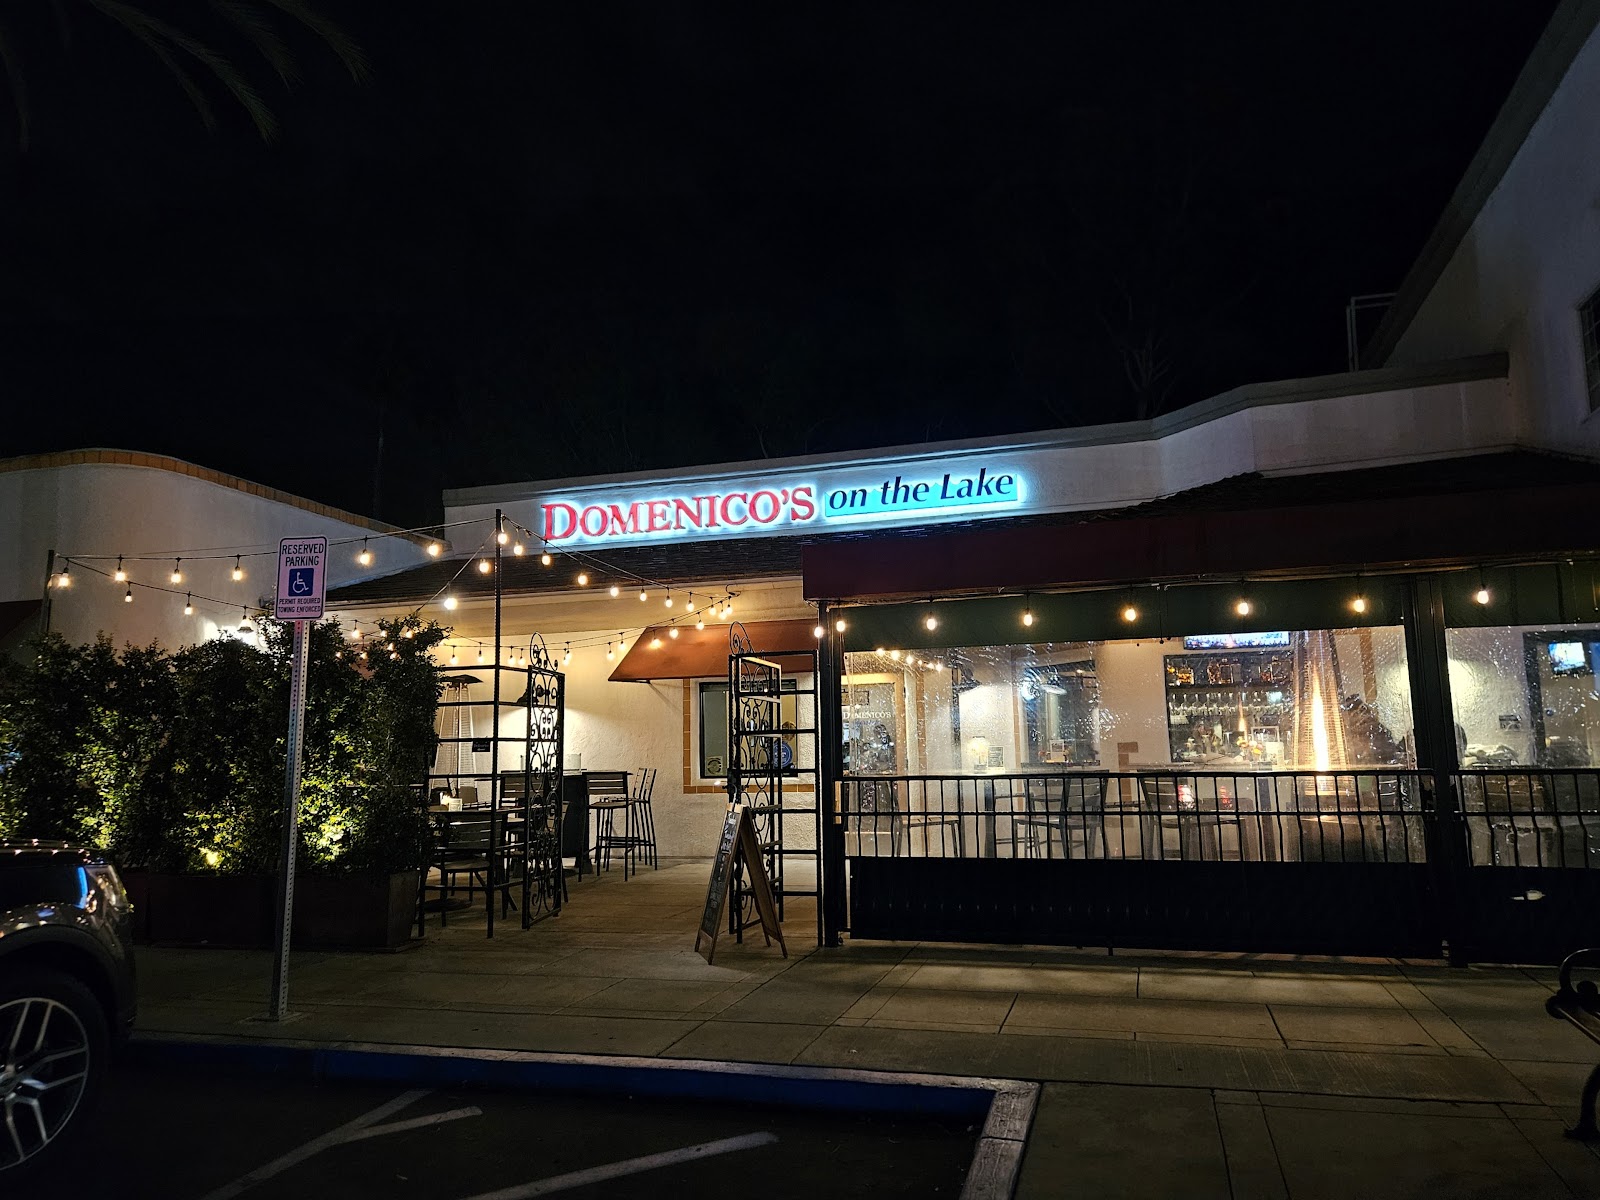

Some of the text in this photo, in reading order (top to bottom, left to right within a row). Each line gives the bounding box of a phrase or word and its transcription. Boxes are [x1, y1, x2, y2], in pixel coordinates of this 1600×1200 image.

[541, 467, 1014, 541] DOMENICO'S on the Lake
[281, 543, 324, 555] RESERVED
[285, 555, 320, 567] PARKING
[297, 597, 321, 605] REQUIRED
[296, 605, 321, 613] ENFORCED
[843, 711, 892, 720] DMENICO'S
